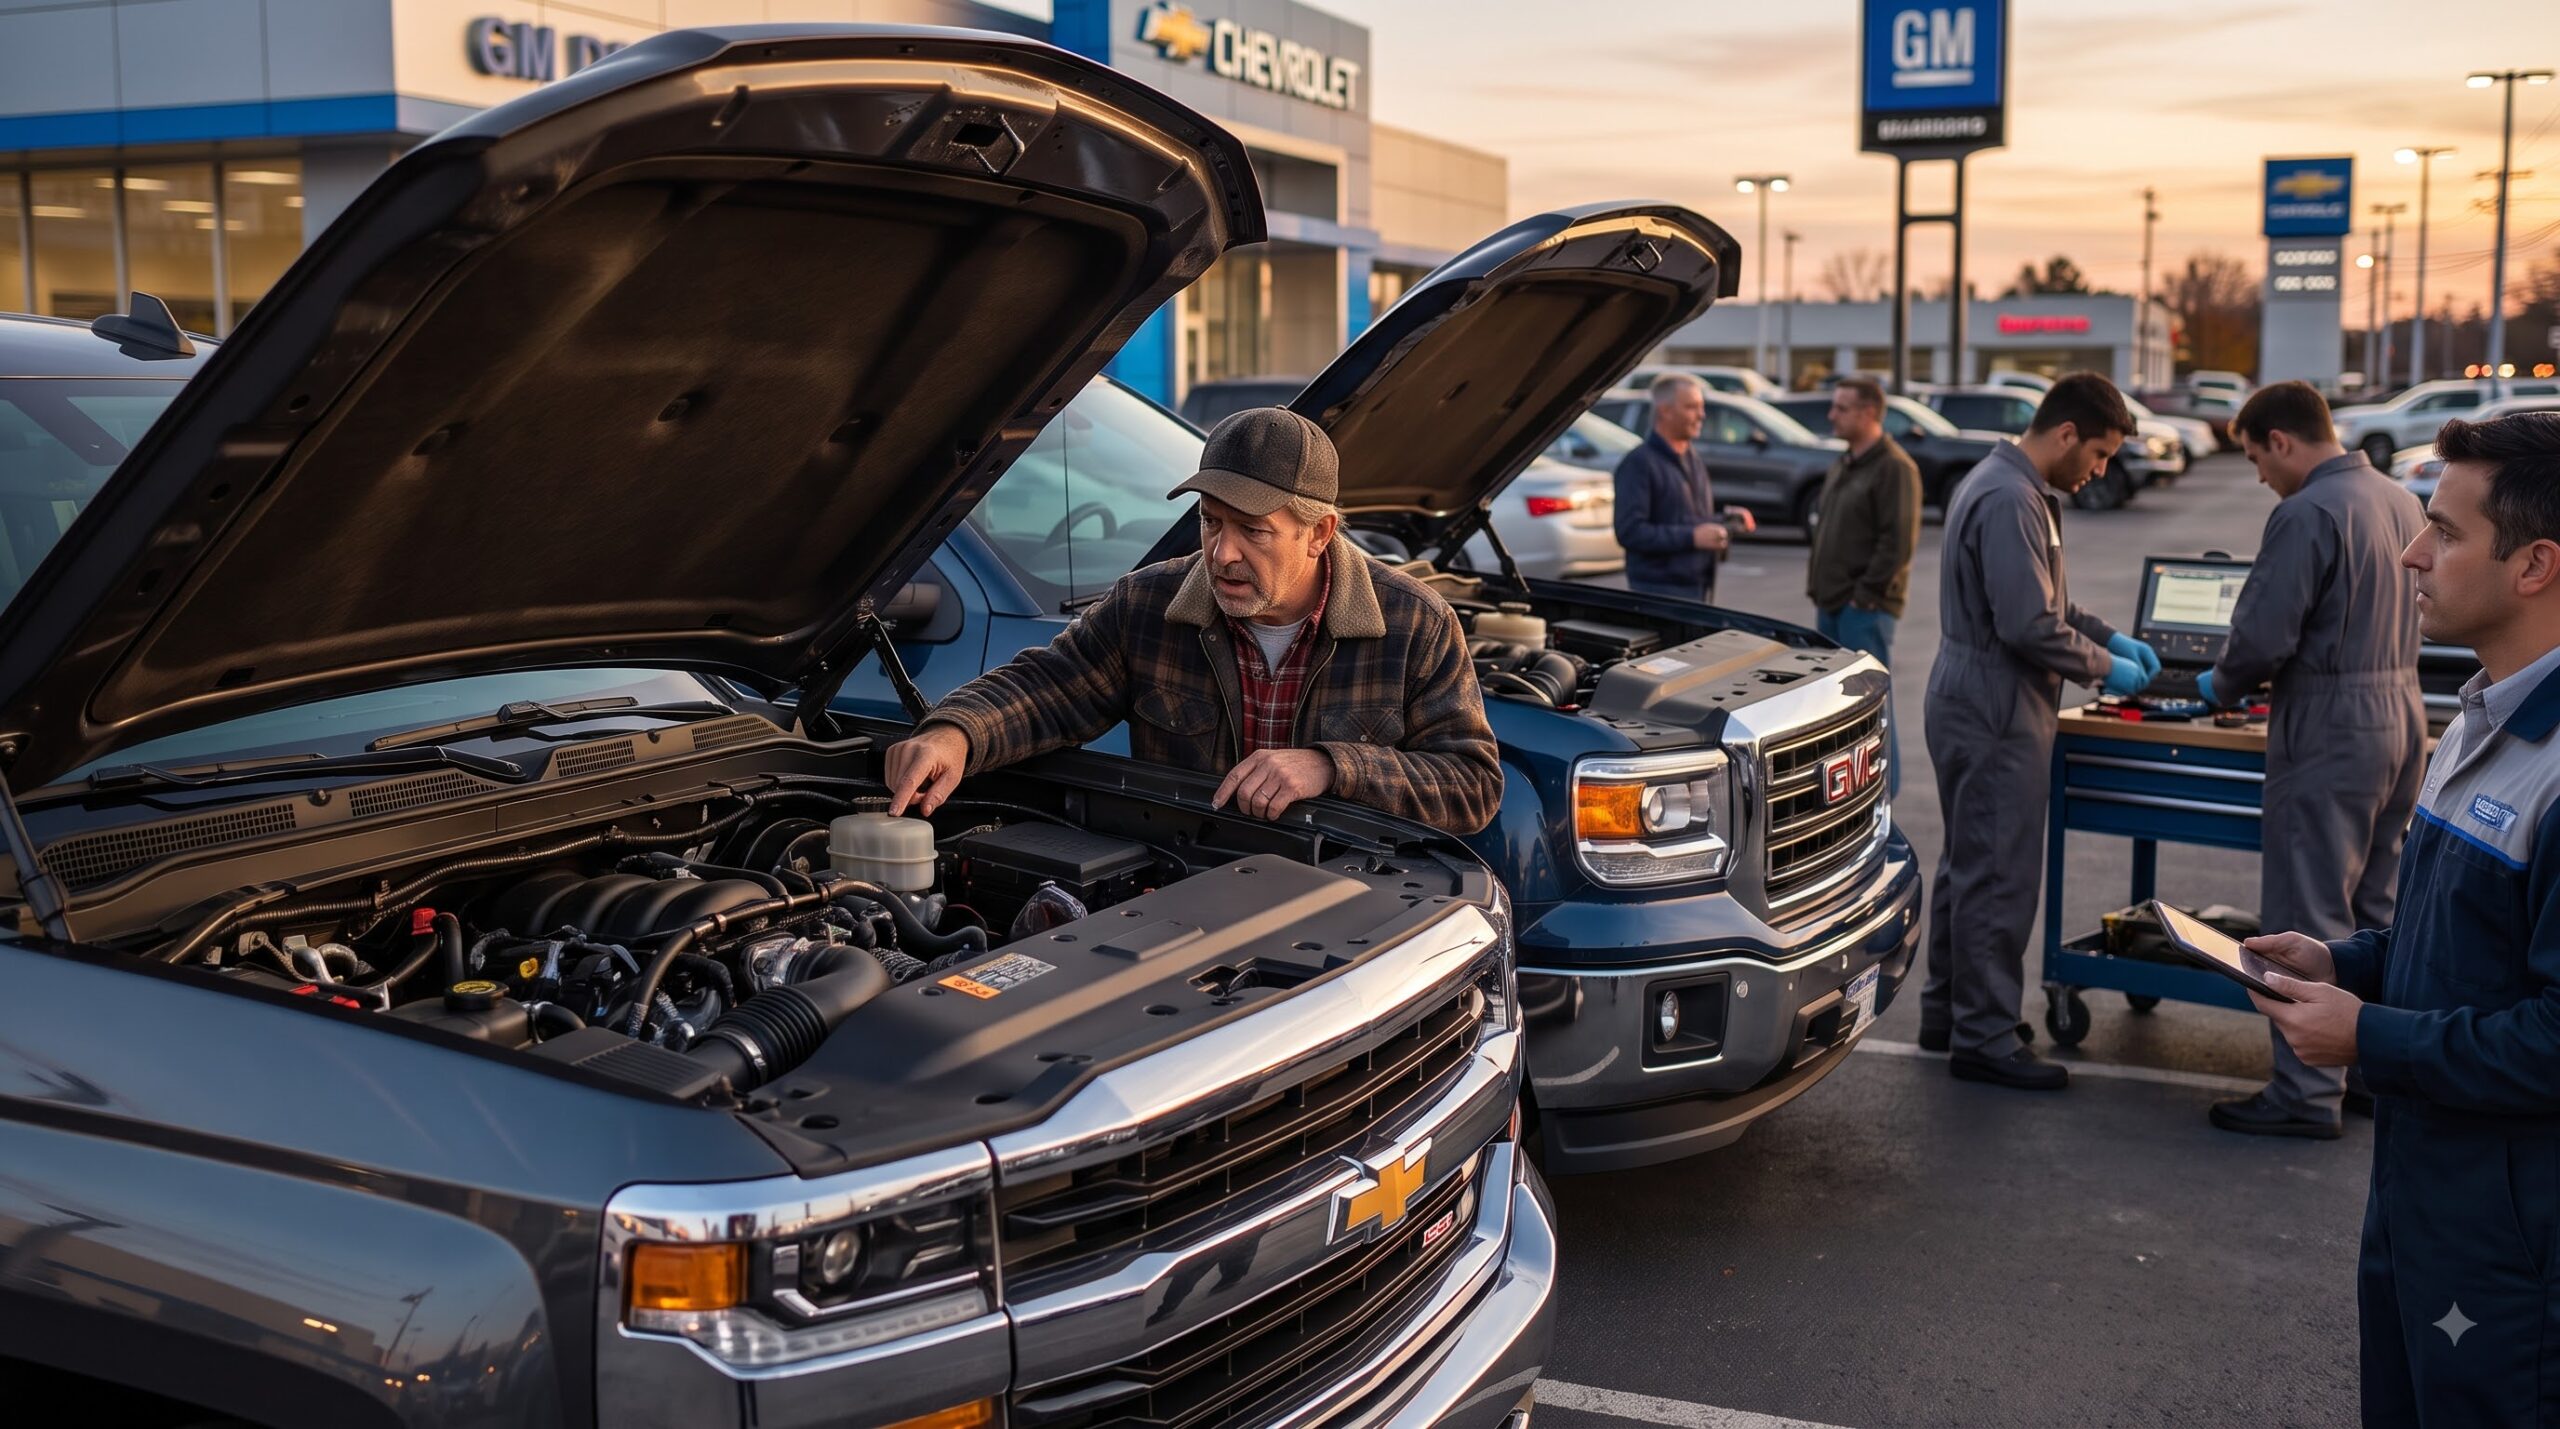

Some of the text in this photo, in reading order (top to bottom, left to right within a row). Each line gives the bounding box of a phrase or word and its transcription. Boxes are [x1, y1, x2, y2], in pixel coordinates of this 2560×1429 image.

[467, 17, 630, 81] GM D
[1210, 18, 1361, 110] CHEVROLET
[1892, 7, 1976, 69] GM
[1823, 735, 1887, 805] GMC
